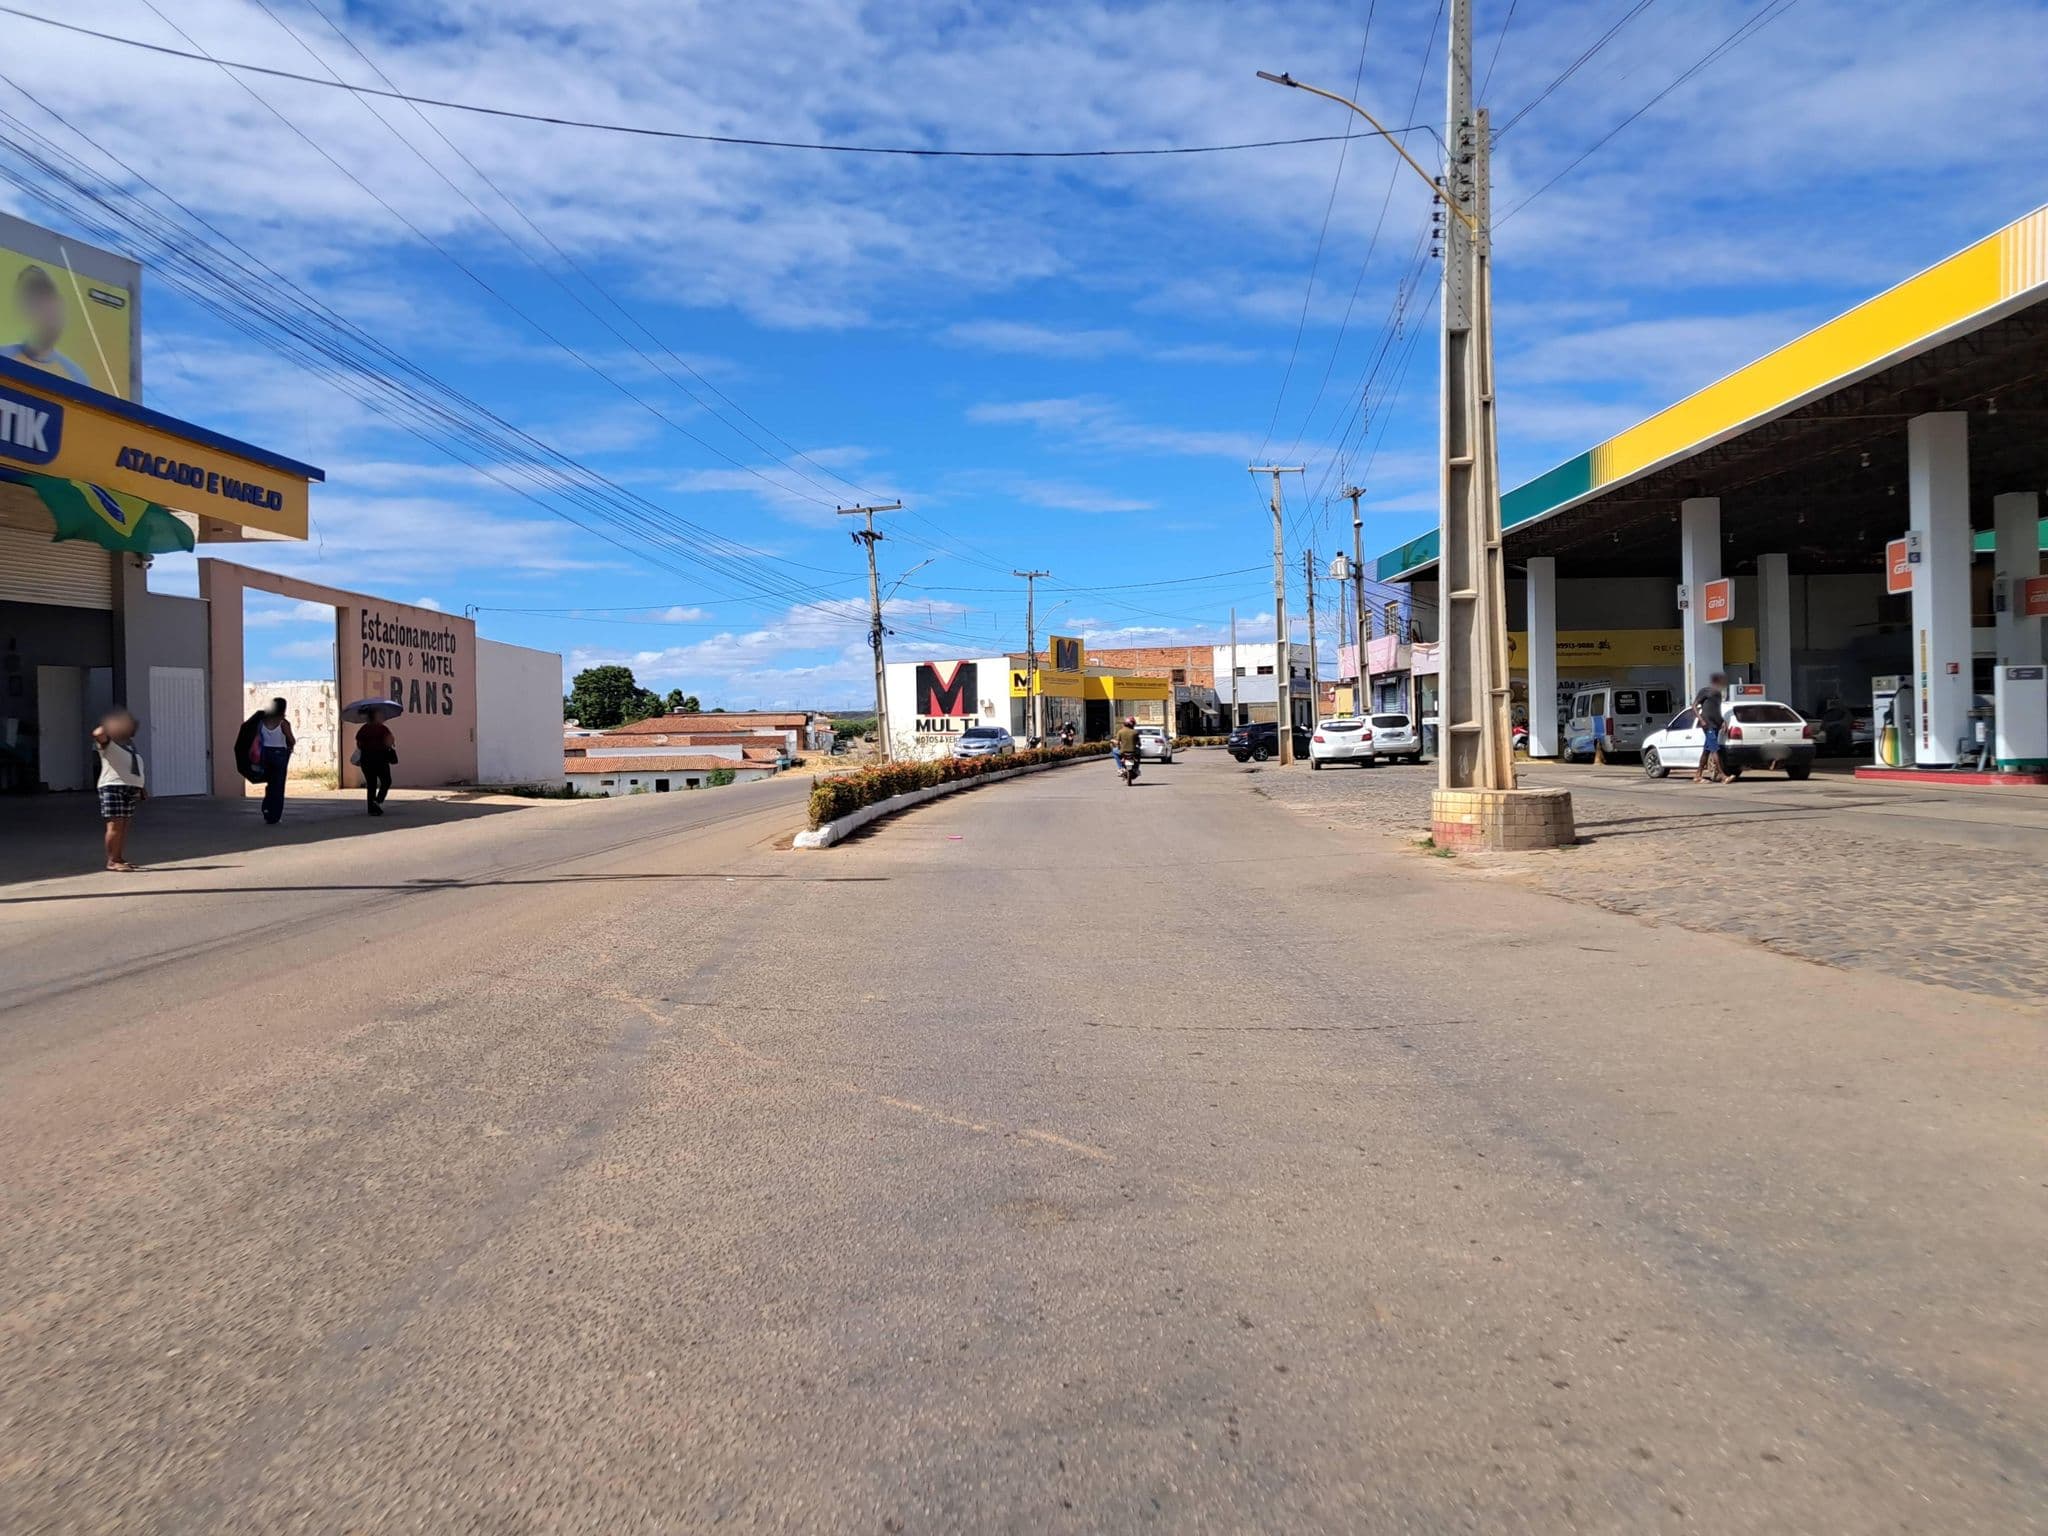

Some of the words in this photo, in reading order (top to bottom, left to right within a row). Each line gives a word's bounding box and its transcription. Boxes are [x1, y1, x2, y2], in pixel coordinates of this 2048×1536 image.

[116, 446, 203, 489] ATACADO
[207, 471, 219, 494] E
[222, 475, 283, 511] VAREJO
[361, 609, 456, 654] Estacionamento
[362, 642, 401, 670] POSTO
[408, 652, 414, 666] e
[421, 652, 454, 677] HOTEL
[916, 660, 978, 717] M
[916, 718, 979, 733] MULTI
